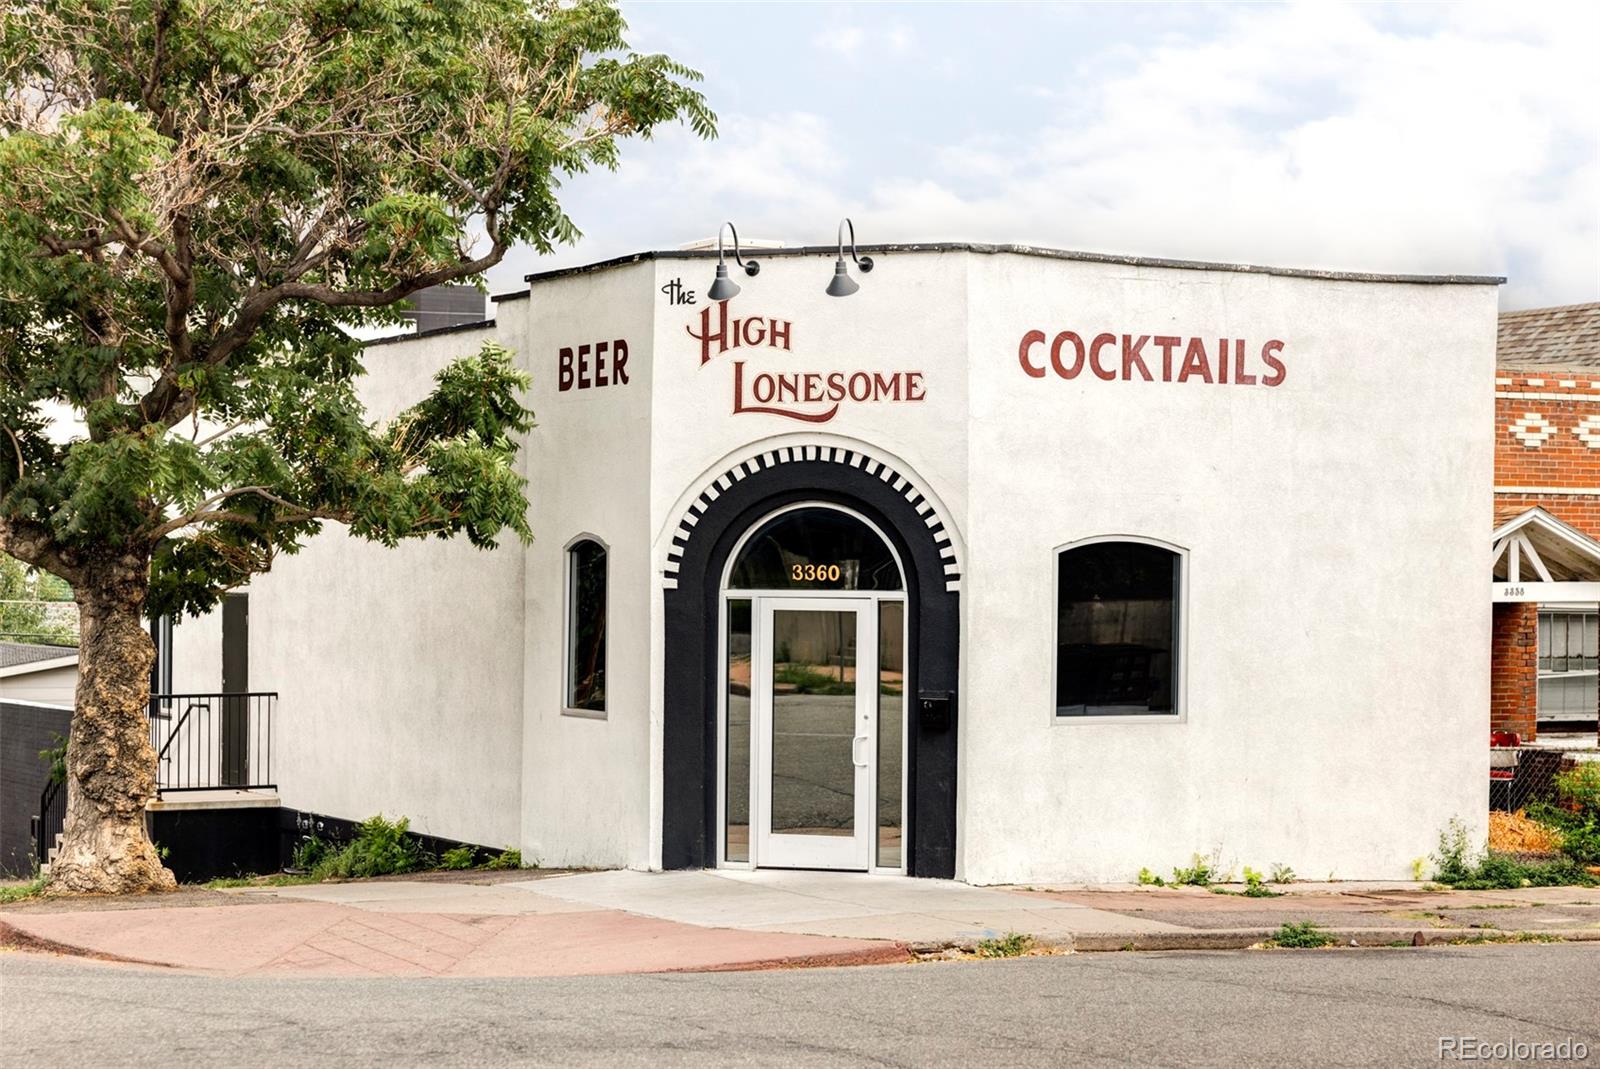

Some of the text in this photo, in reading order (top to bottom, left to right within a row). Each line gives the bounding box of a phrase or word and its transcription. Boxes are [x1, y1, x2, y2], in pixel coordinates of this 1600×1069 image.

[685, 299, 792, 367] HIGH
[1018, 329, 1287, 387] COCKTAILS
[558, 339, 630, 392] BEER
[733, 361, 926, 424] LONESOME
[792, 564, 840, 582] 3360
